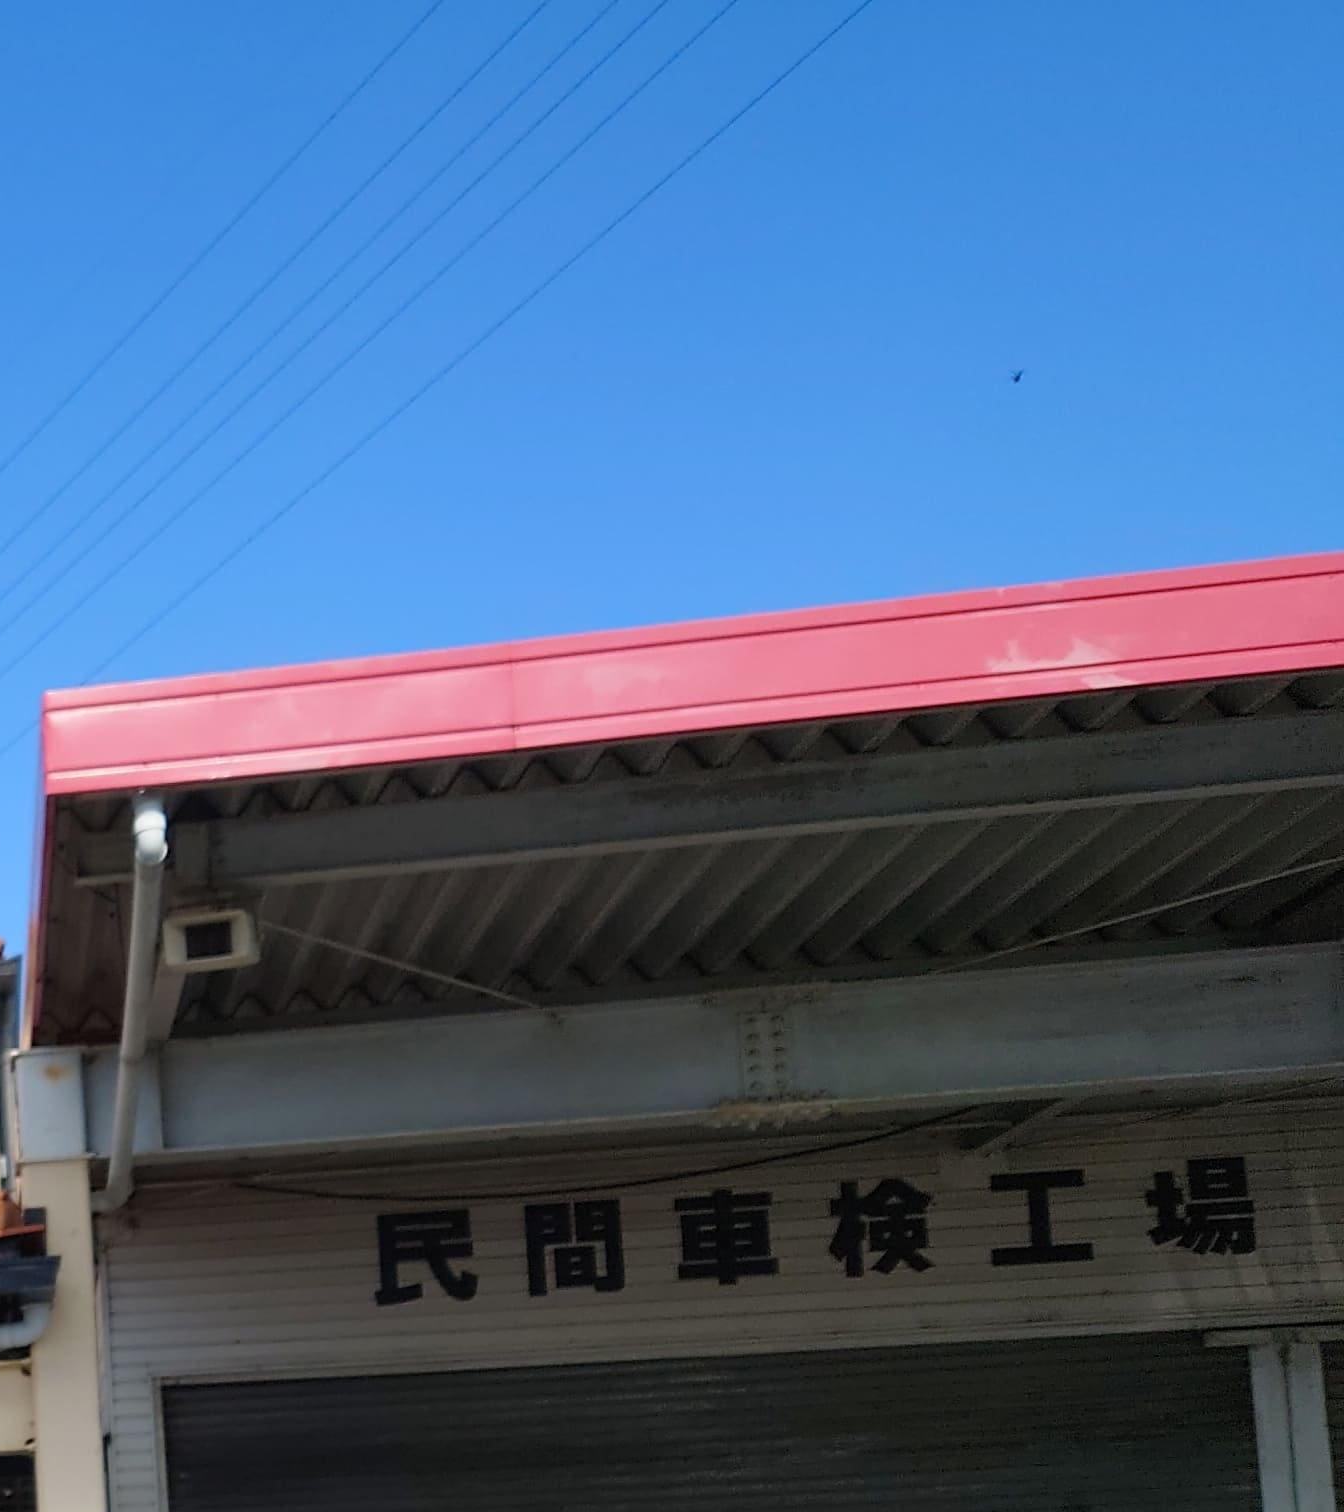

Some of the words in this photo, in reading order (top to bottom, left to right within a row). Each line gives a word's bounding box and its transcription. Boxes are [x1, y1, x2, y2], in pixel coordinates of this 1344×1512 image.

[374, 1156, 1258, 1305] 民間車検工場
